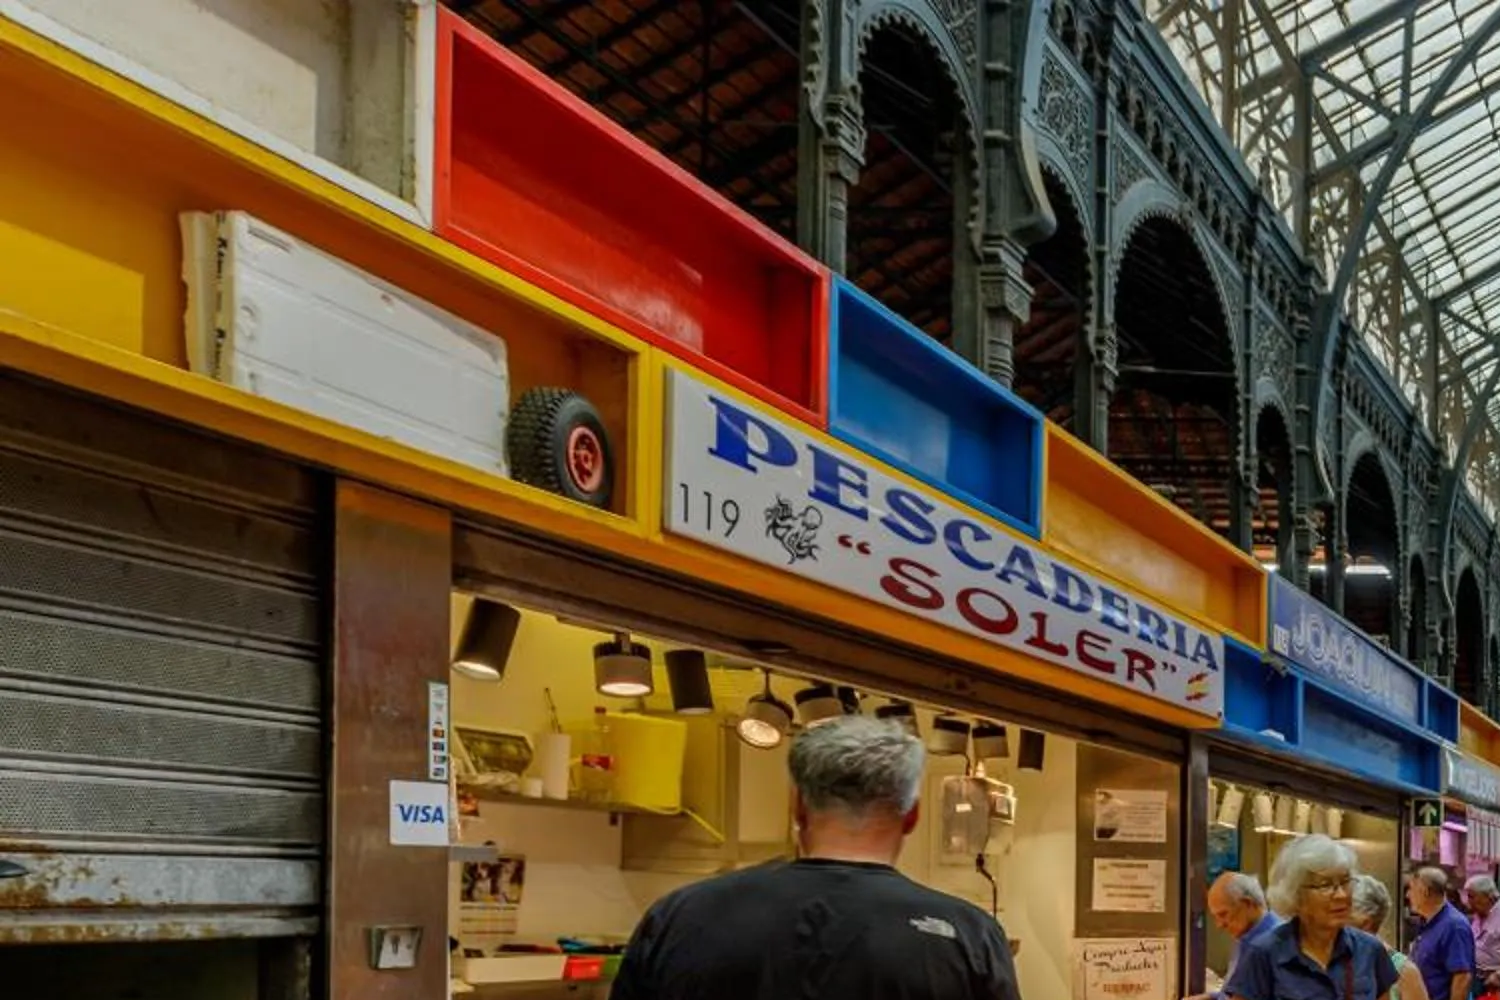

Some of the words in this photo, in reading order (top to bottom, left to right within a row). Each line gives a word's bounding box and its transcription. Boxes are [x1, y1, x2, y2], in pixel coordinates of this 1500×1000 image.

[679, 483, 740, 538] 119
[708, 396, 1219, 672] PESCADERIA
[395, 803, 445, 824] VISA
